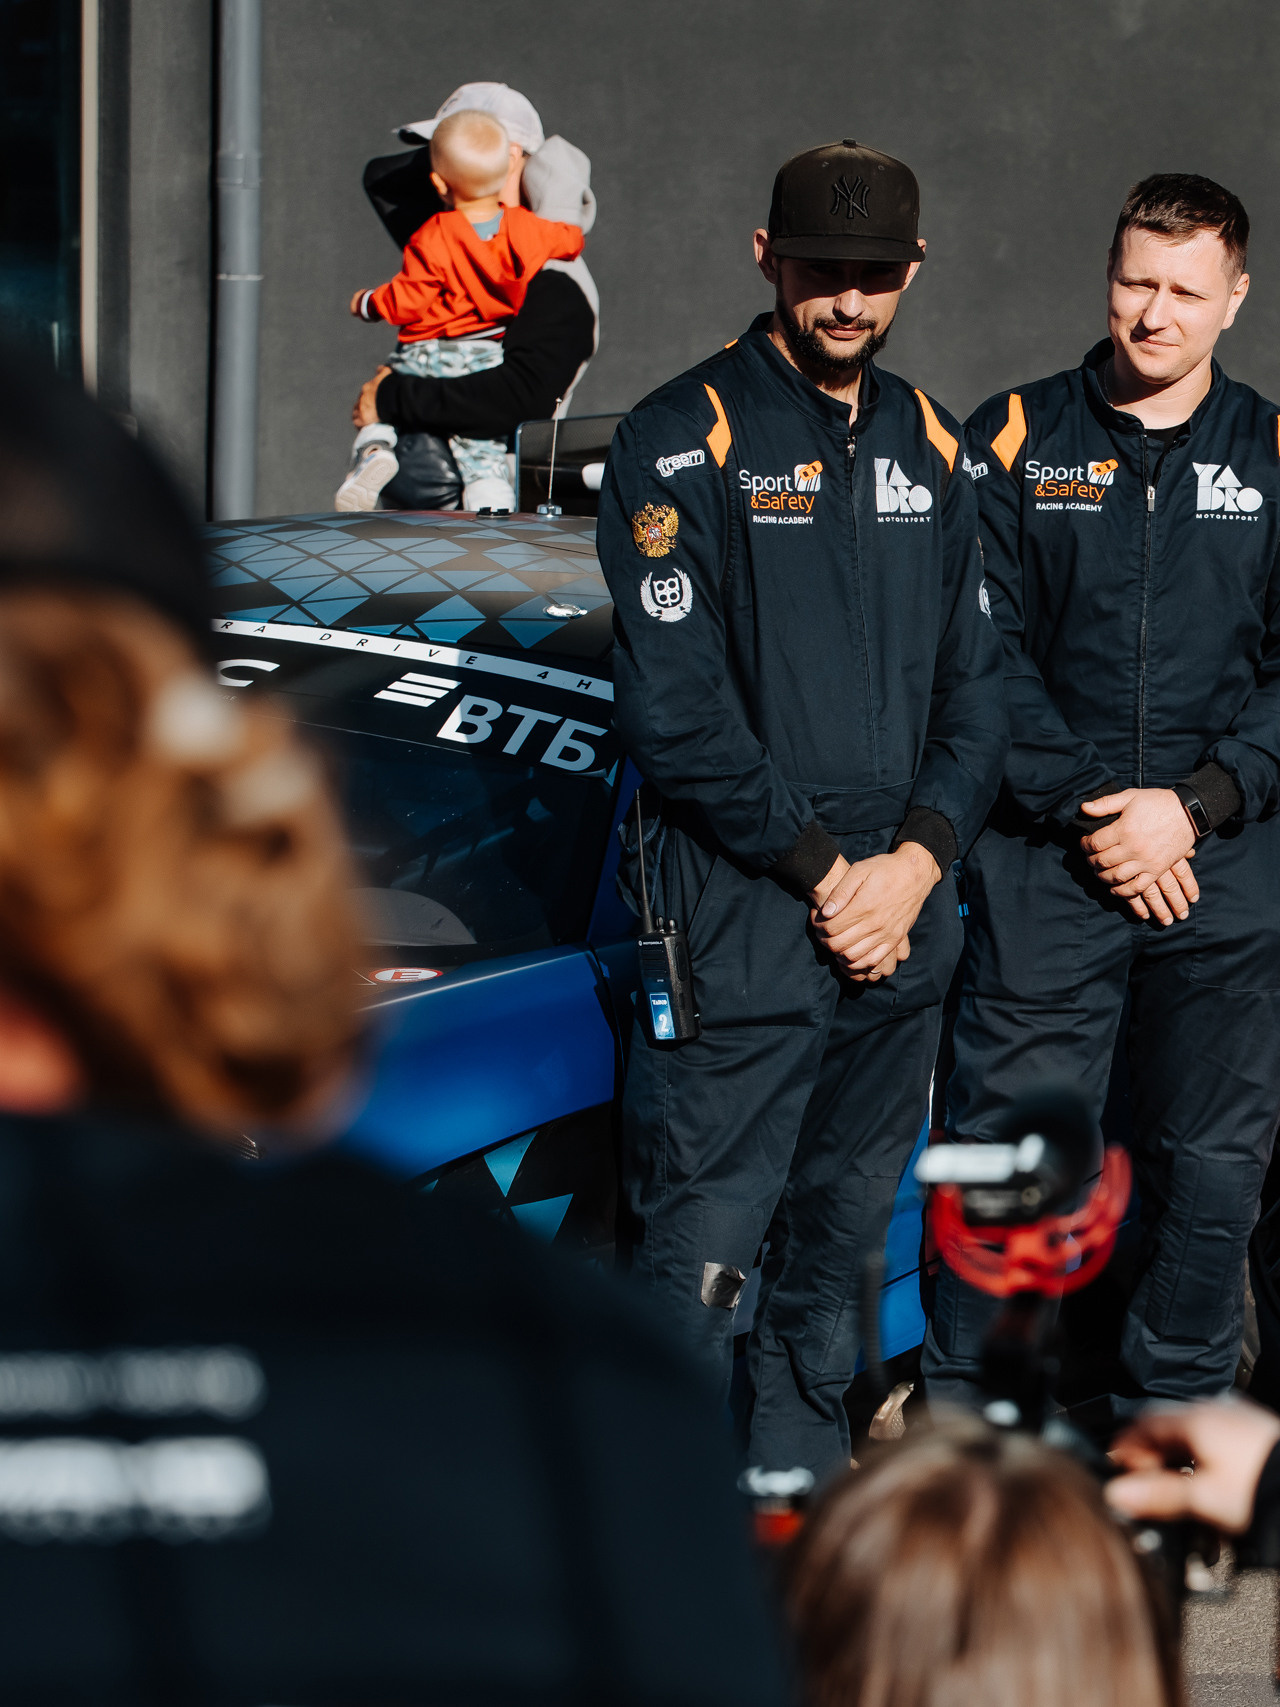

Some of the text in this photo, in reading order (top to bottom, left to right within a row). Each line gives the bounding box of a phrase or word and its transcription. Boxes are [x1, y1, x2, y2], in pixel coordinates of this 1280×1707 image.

[656, 450, 706, 477] freem
[1025, 460, 1085, 485] Sport
[739, 469, 793, 496] Sport
[1034, 480, 1106, 502] &Safety
[750, 491, 815, 514] &Safety
[1036, 502, 1103, 513] RACING ACADEMY
[752, 515, 814, 525] RACING ACADEMY
[658, 1013, 669, 1033] 2
